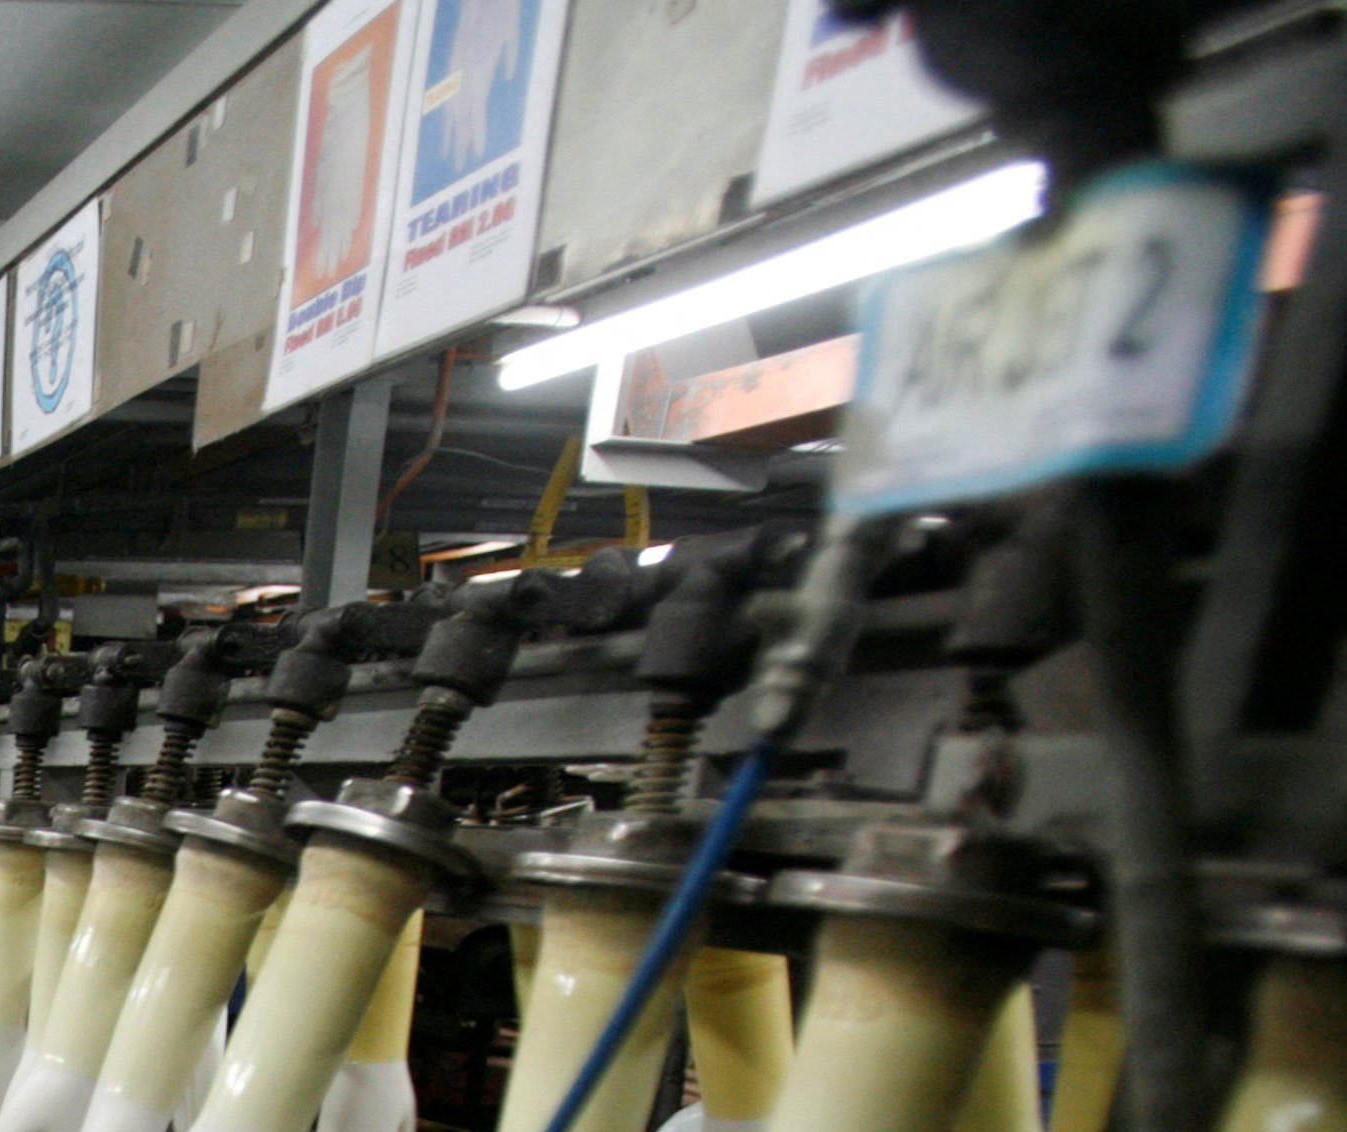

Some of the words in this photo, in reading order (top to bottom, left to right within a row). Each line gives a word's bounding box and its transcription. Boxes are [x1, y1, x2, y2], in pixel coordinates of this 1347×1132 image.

[407, 161, 521, 243] TEARING
[287, 290, 339, 334] Double
[1105, 236, 1175, 362] 2
